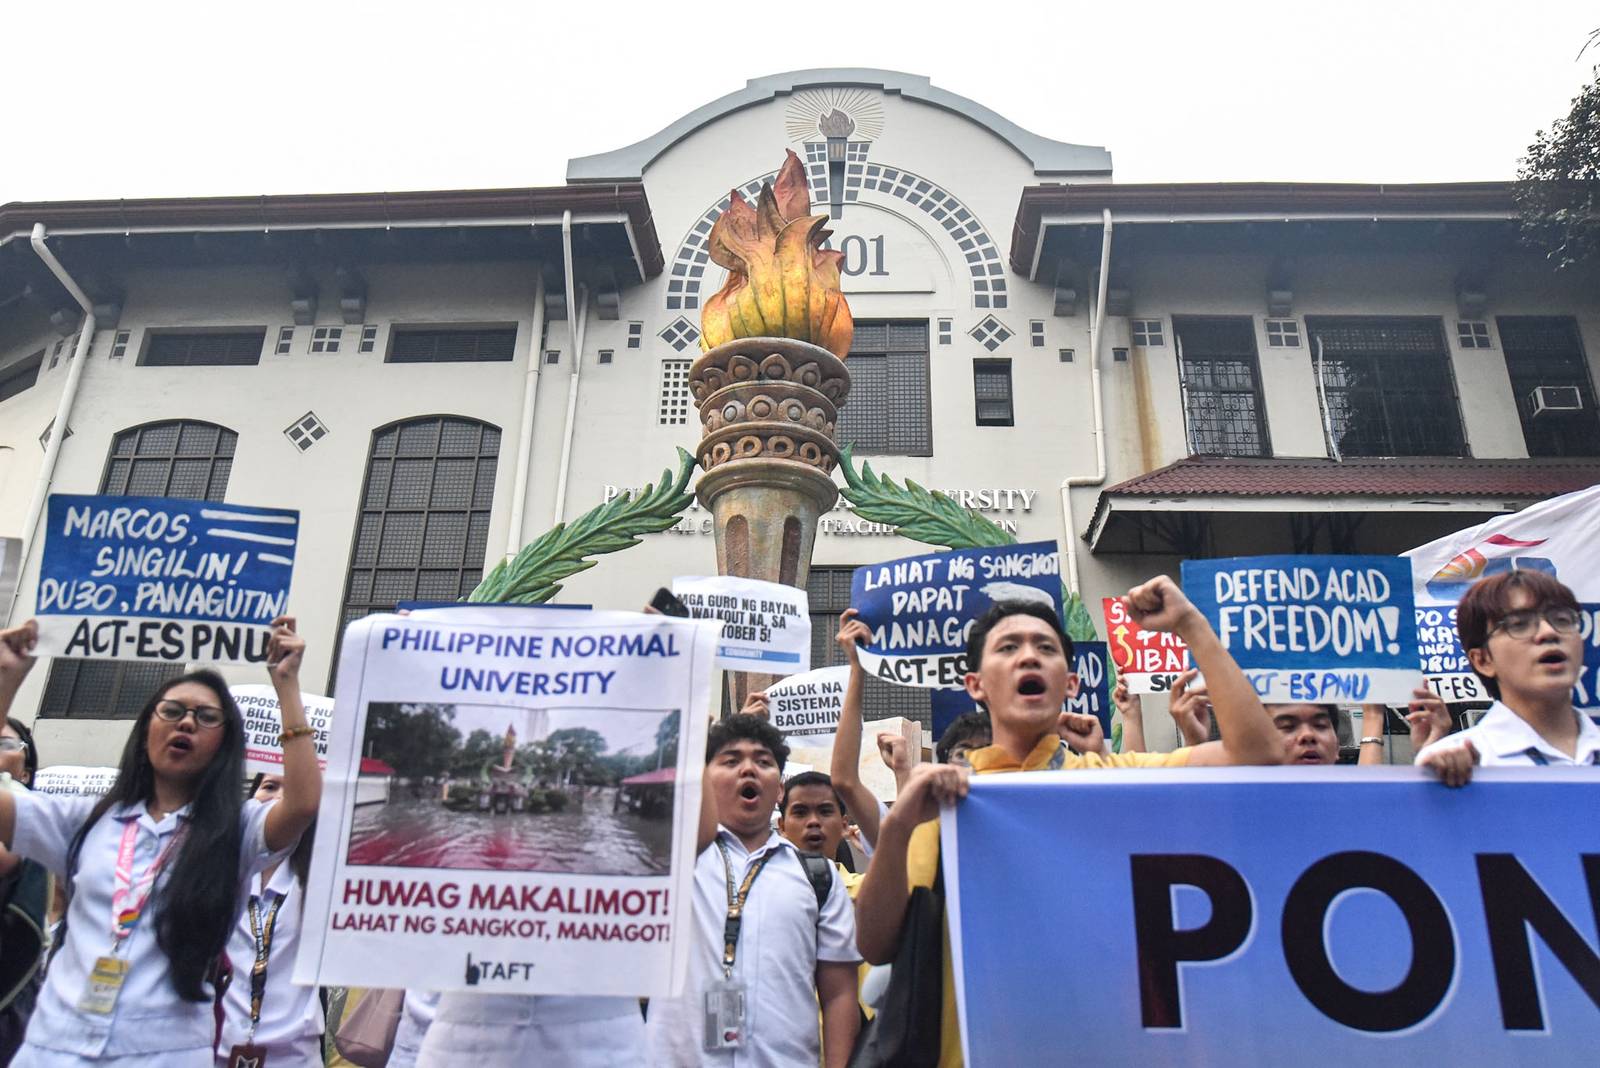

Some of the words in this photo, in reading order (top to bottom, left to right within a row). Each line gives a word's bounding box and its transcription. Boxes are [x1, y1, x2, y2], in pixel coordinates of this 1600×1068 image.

[826, 234, 890, 276] 01
[63, 505, 198, 546] MARCOS,
[90, 545, 249, 586] SINGILIN!
[864, 557, 942, 592] LAHAT
[947, 555, 975, 582] NG
[979, 551, 1060, 579] SANGKOT
[39, 577, 130, 613] DU30,
[892, 584, 970, 616] DAPAT
[1215, 567, 1321, 604] DEFEND
[1324, 566, 1391, 604] ACAD
[677, 593, 704, 607] MGA
[708, 594, 738, 610] GURO
[741, 598, 757, 612] NG
[760, 600, 801, 618] BAYAN,
[749, 611, 769, 631] NA,
[771, 615, 787, 630] SA
[381, 627, 543, 659] PHILIPPINE
[550, 632, 680, 659] NORMAL
[759, 628, 772, 643] 5!
[1219, 604, 1401, 657] FREEDOM!
[440, 666, 617, 697] UNIVERSITY
[821, 681, 843, 694] NA
[1430, 676, 1478, 700] T-ES
[246, 707, 277, 723] BILL,
[310, 717, 326, 728] TO
[775, 710, 841, 727] BAGUHIN
[777, 695, 842, 712] SISTEMA
[83, 785, 110, 795] BUD
[342, 879, 461, 910] HUWAG
[468, 883, 670, 917] MAKALIMOT!
[332, 911, 397, 932] LAHAT
[403, 914, 436, 935] NG
[442, 916, 552, 943] SANGKOT,
[556, 921, 671, 943] MANAGOT!
[480, 961, 535, 981] TAFT
